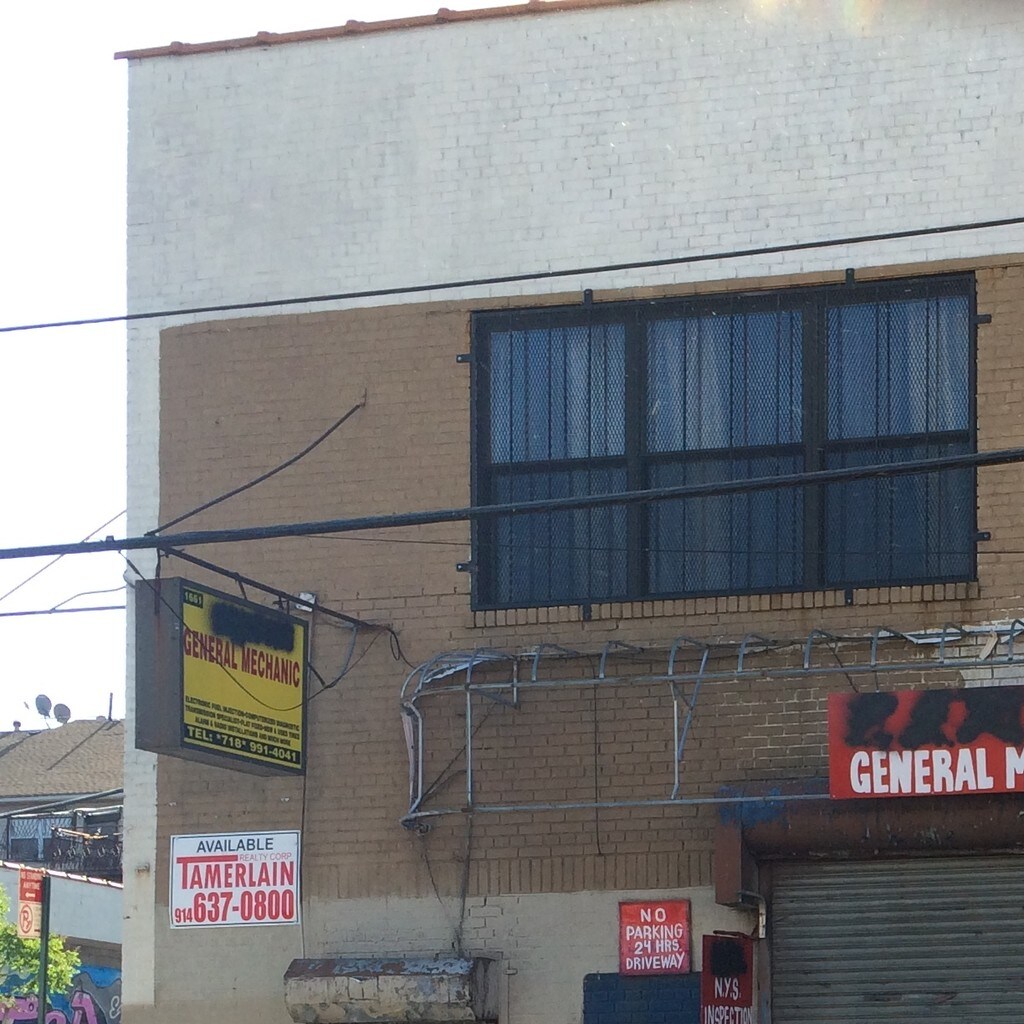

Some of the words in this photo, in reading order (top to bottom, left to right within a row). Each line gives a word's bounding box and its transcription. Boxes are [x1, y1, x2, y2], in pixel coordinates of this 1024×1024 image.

[184, 628, 238, 670] GENERAL
[241, 647, 300, 688] MECHANIC
[187, 726, 213, 742] TEL:
[249, 742, 297, 762] 991-4041
[850, 747, 994, 794] GENERAL
[196, 838, 274, 853] AVAILABLE
[239, 853, 269, 862] REALTY
[269, 852, 292, 861] CORP
[176, 854, 294, 890] TAMERLAIN
[174, 908, 193, 923] 914
[193, 889, 294, 923] 637-0800
[640, 907, 666, 922] NO
[626, 923, 684, 941] PARKING
[634, 941, 651, 955] 24
[626, 952, 685, 970] DRIVEWAY
